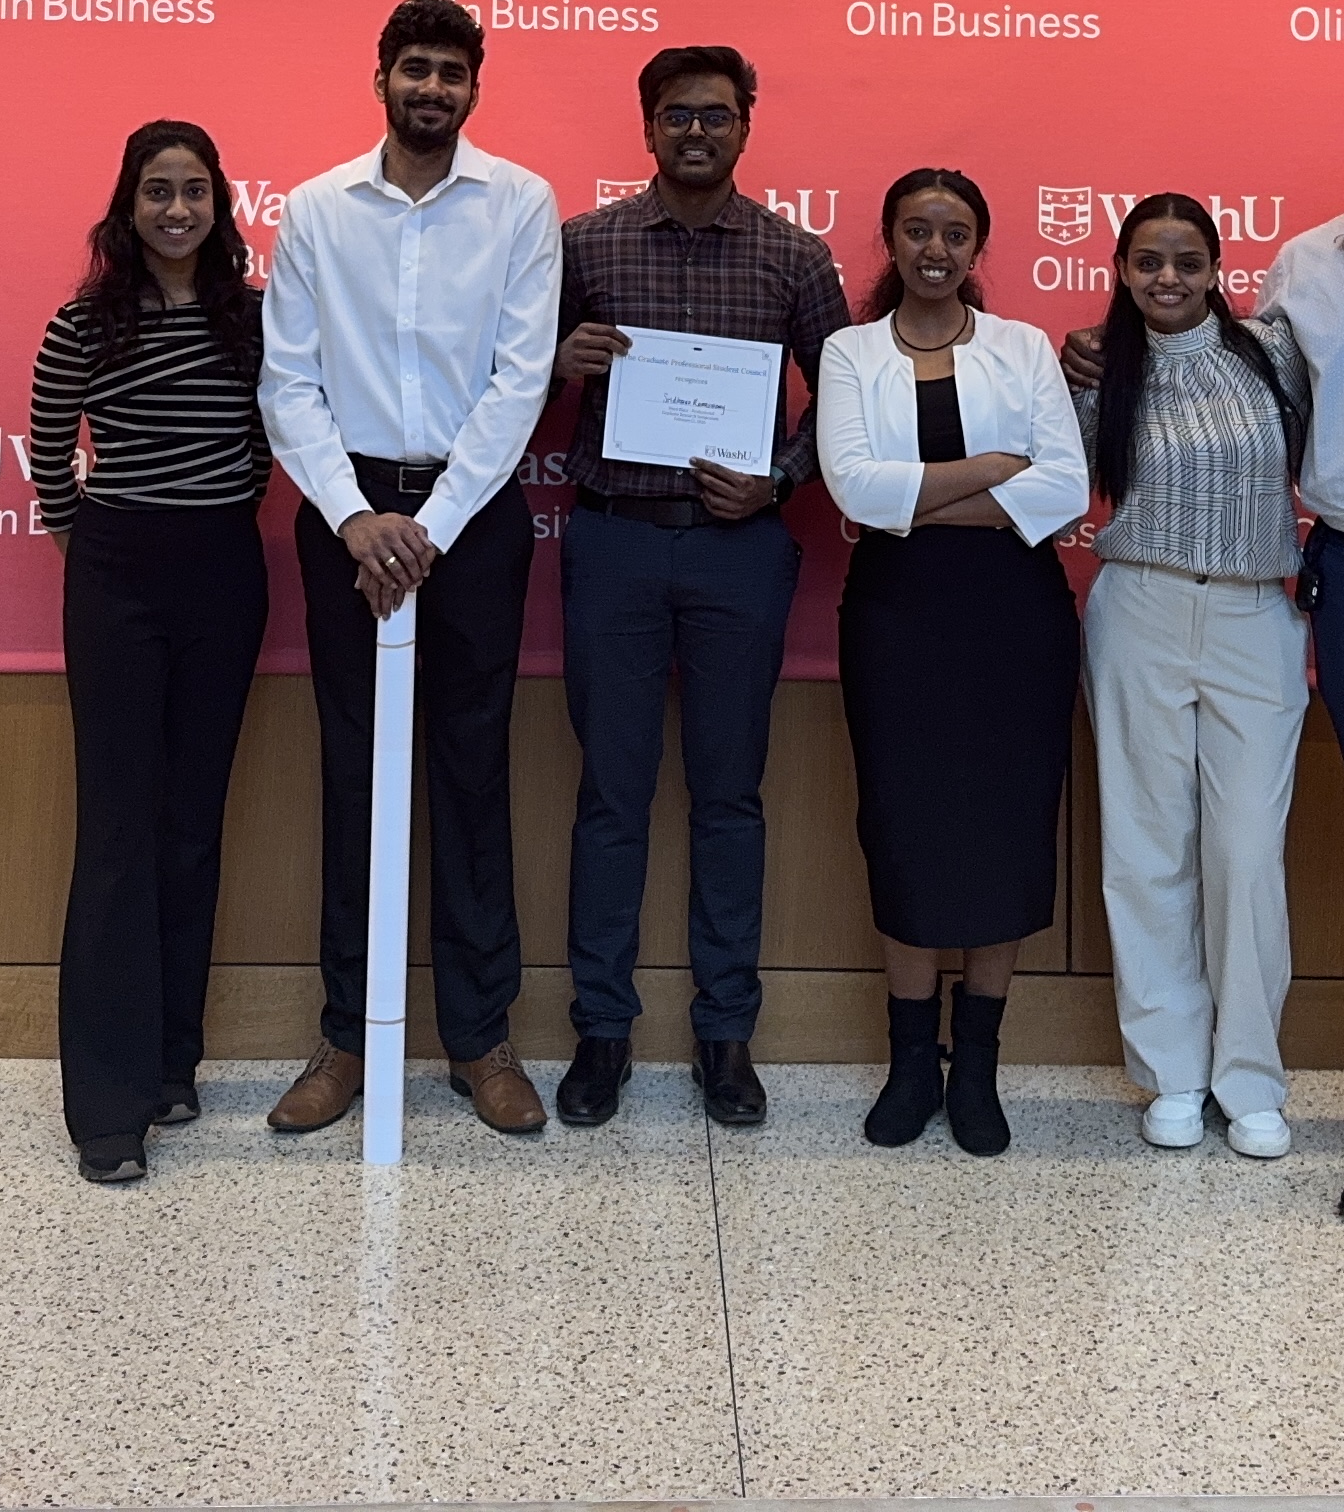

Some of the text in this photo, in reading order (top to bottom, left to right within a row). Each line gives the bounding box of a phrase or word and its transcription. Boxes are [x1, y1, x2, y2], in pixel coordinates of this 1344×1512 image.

[846, 1, 1101, 39] Olin Business
[1032, 255, 1110, 292] Olin
[741, 367, 768, 377] Council
[716, 447, 752, 461] WashU
